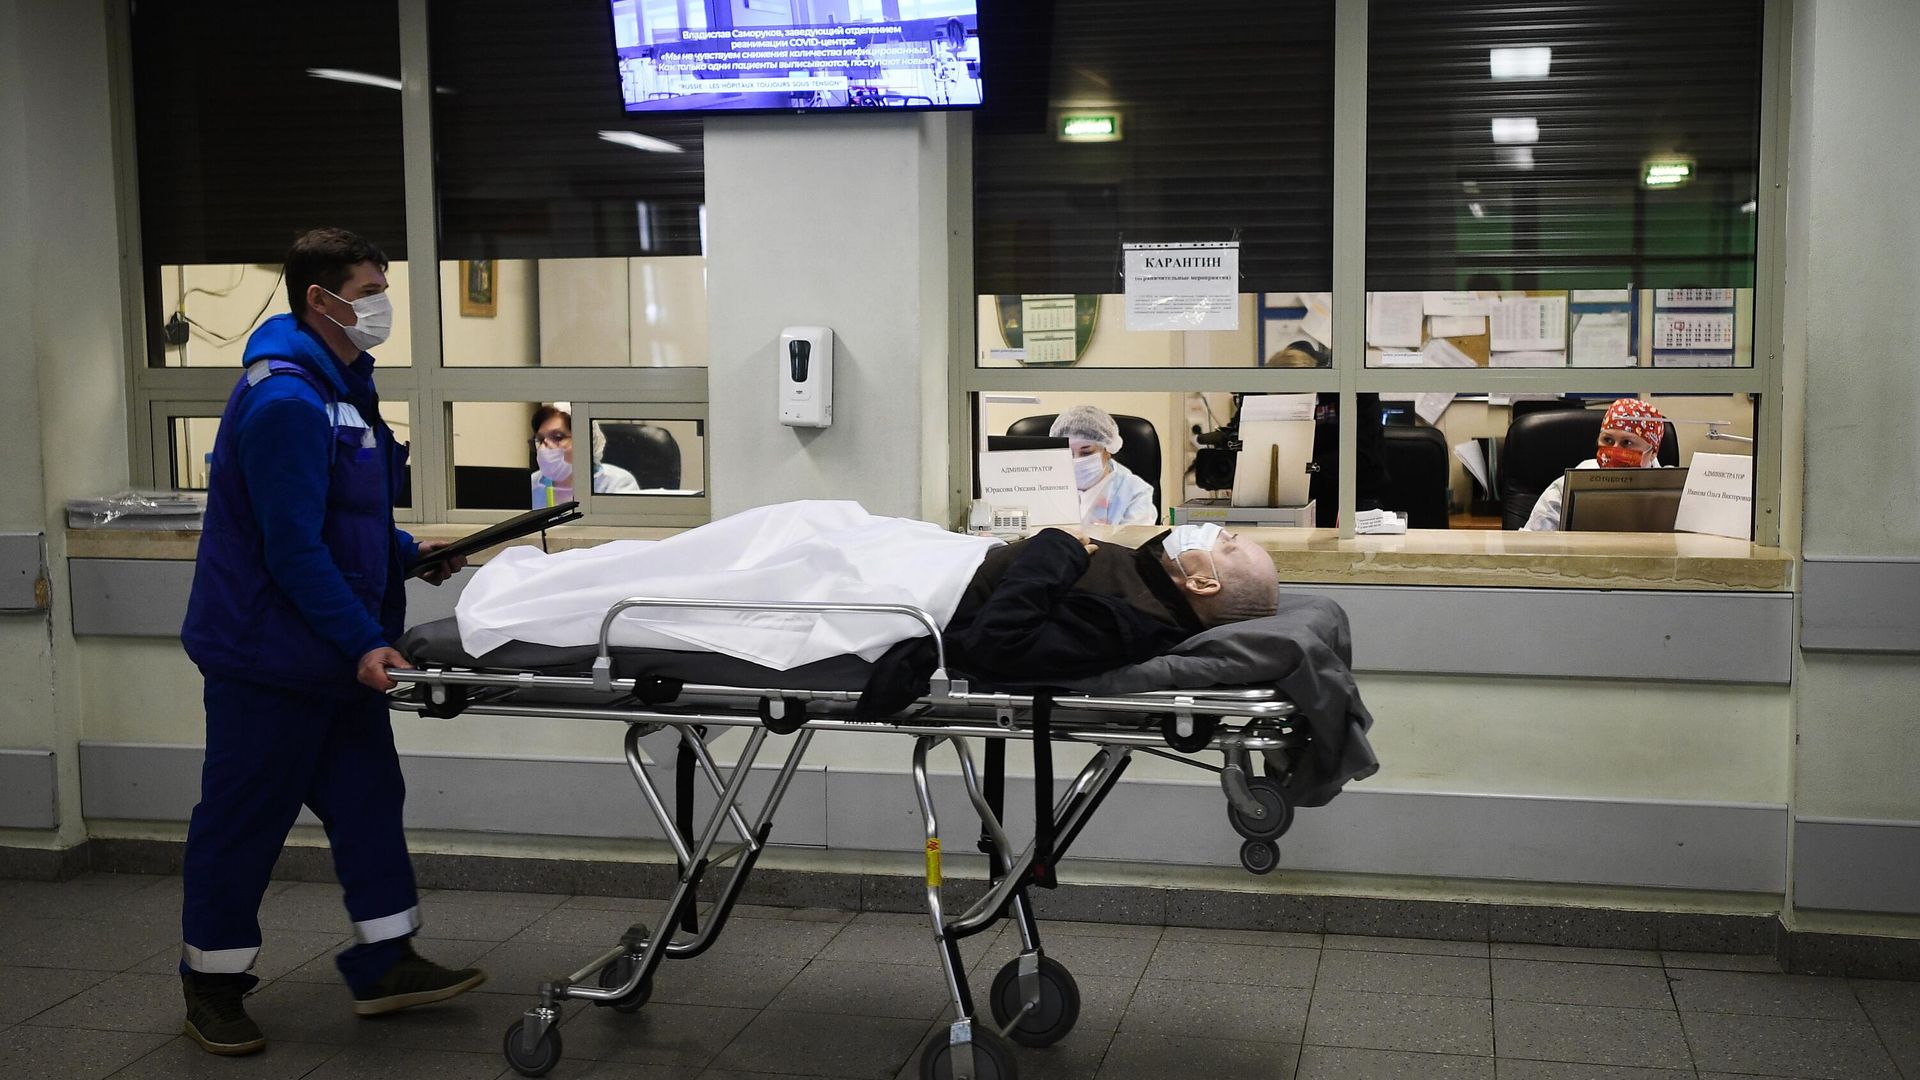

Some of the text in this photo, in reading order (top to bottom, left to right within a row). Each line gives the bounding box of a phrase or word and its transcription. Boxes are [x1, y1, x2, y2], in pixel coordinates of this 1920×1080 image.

[682, 25, 902, 41] Владислав Саморуков, заведующий отделением
[731, 40, 789, 50] реанимации
[695, 52, 741, 61] чувствуем
[741, 50, 789, 59] снижения
[789, 48, 842, 57] количества
[658, 63, 675, 72] Как
[677, 62, 706, 71] только
[708, 62, 731, 71] одни
[732, 61, 778, 71] пациенты
[779, 59, 850, 69] выписываются,
[850, 58, 900, 68] поступают
[1145, 256, 1222, 268] КАРАНТИН
[1000, 465, 1053, 474] АДМИНИСТРАТОР
[1703, 470, 1745, 480] АДМИНИСТРАТОР
[984, 486, 1013, 495] Юрасова
[1014, 485, 1036, 493] Оксана
